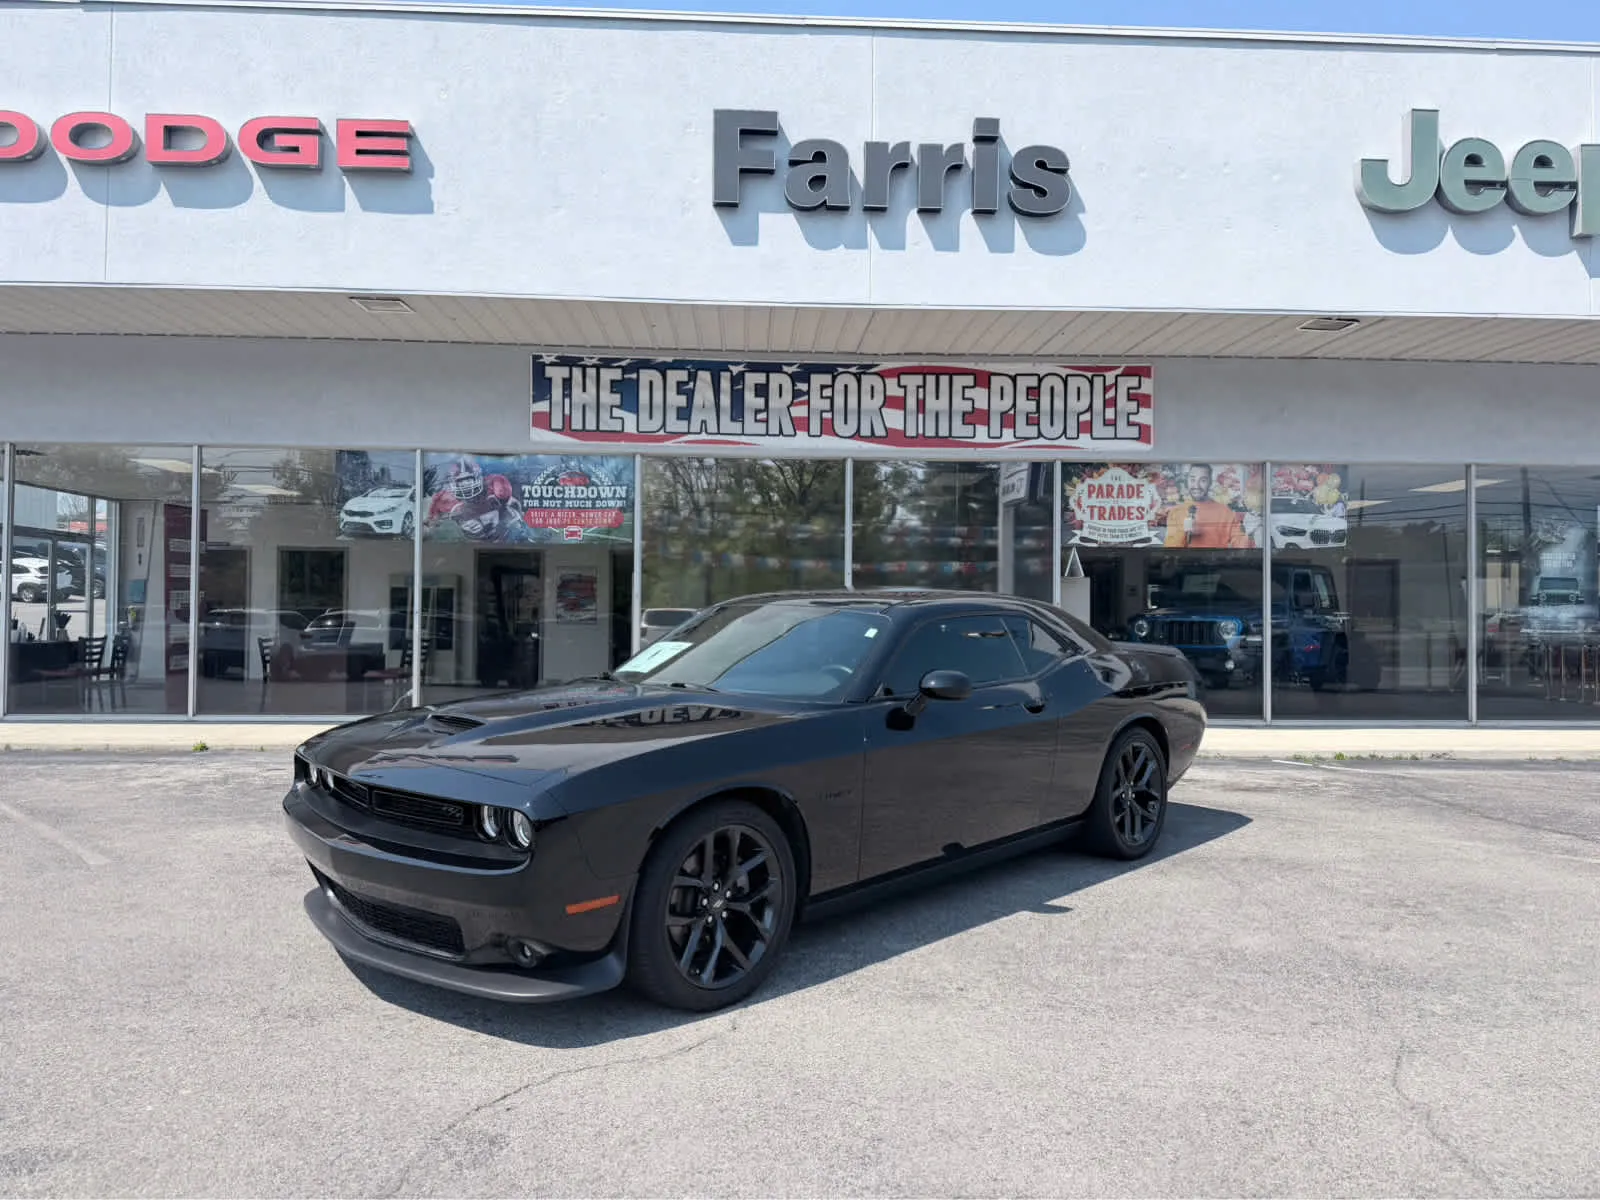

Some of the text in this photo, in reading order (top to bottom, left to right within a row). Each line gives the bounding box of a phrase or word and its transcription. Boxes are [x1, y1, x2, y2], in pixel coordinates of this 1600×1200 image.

[712, 109, 1072, 216] Farris
[1354, 108, 1600, 239] Jee
[544, 365, 1142, 440] THE DEALER FOR THE PEOPLE
[521, 485, 628, 498] TOUCHDOWN
[1087, 483, 1145, 499] PARADE
[523, 500, 540, 508] FOR
[542, 500, 561, 508] NOT
[565, 500, 593, 508] MUCH
[1087, 505, 1146, 521] TRADES
